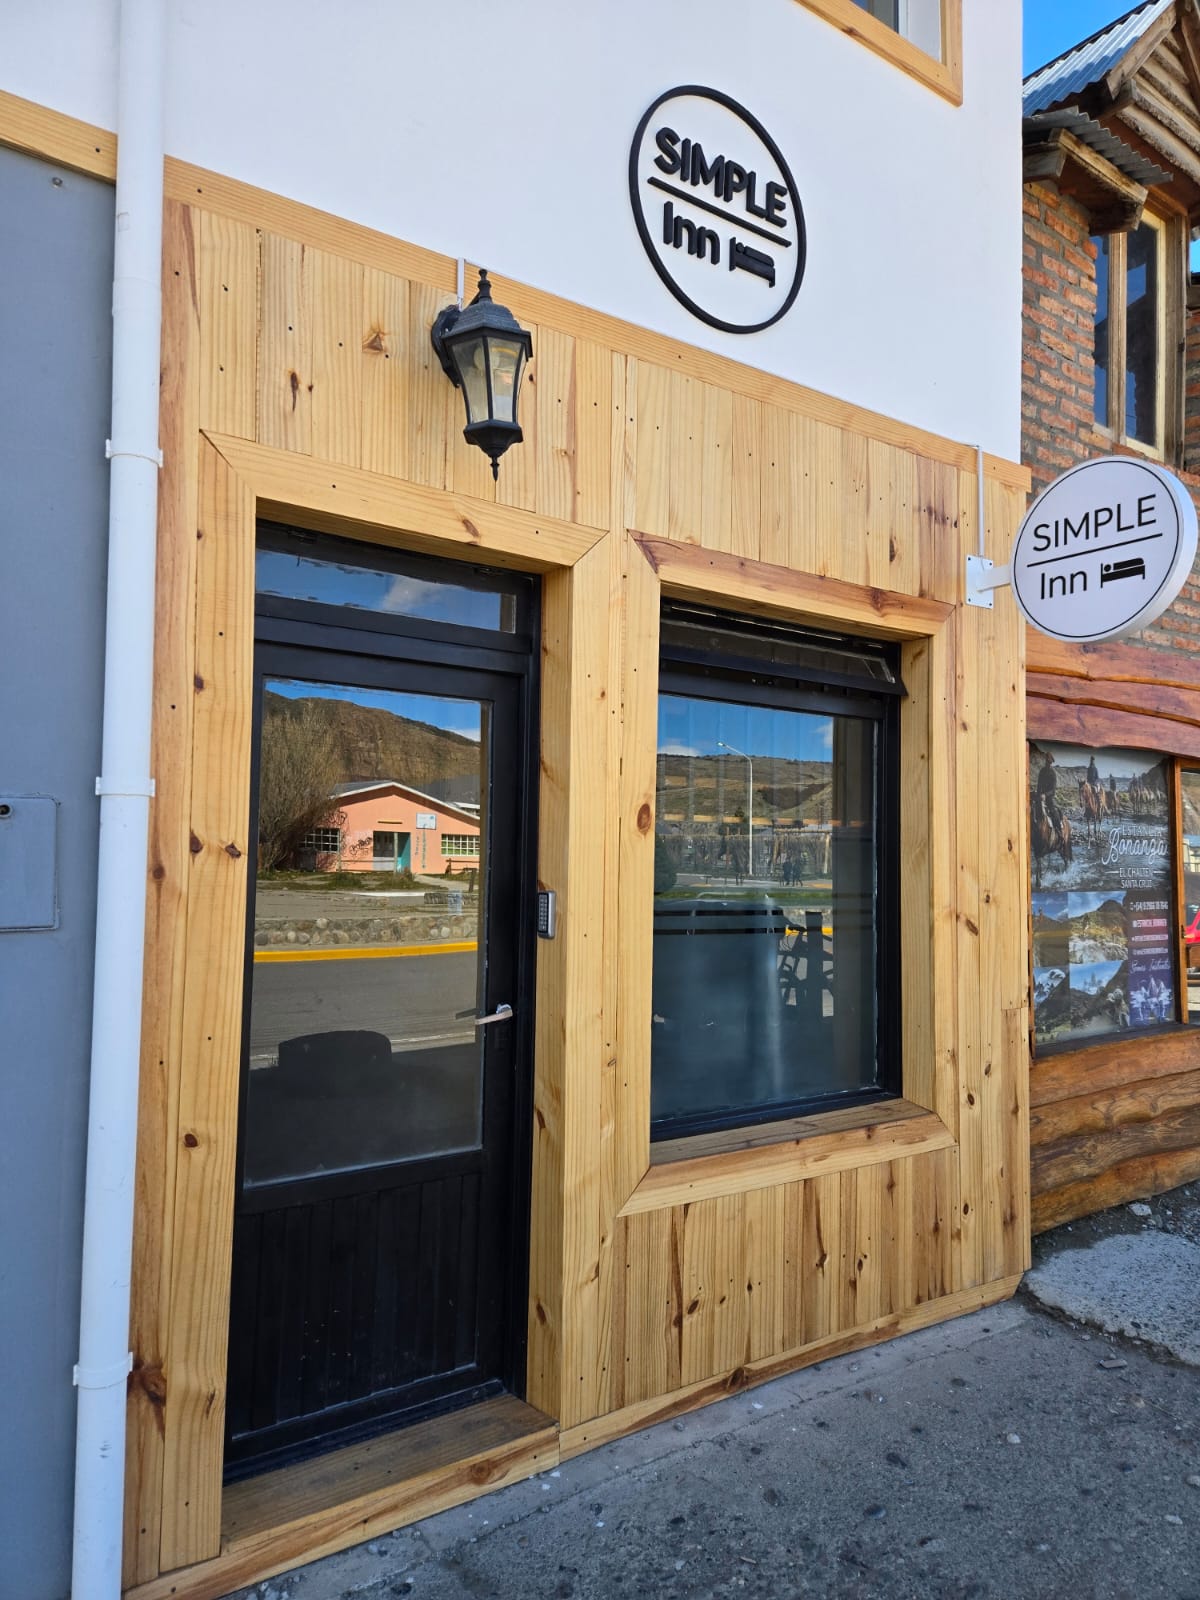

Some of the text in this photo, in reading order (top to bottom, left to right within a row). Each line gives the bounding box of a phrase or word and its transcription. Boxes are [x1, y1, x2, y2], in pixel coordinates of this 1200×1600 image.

[654, 127, 788, 228] SIMPLE
[663, 201, 720, 265] Inn
[1033, 494, 1157, 552] SIMPLE
[1040, 570, 1088, 600] Inn
